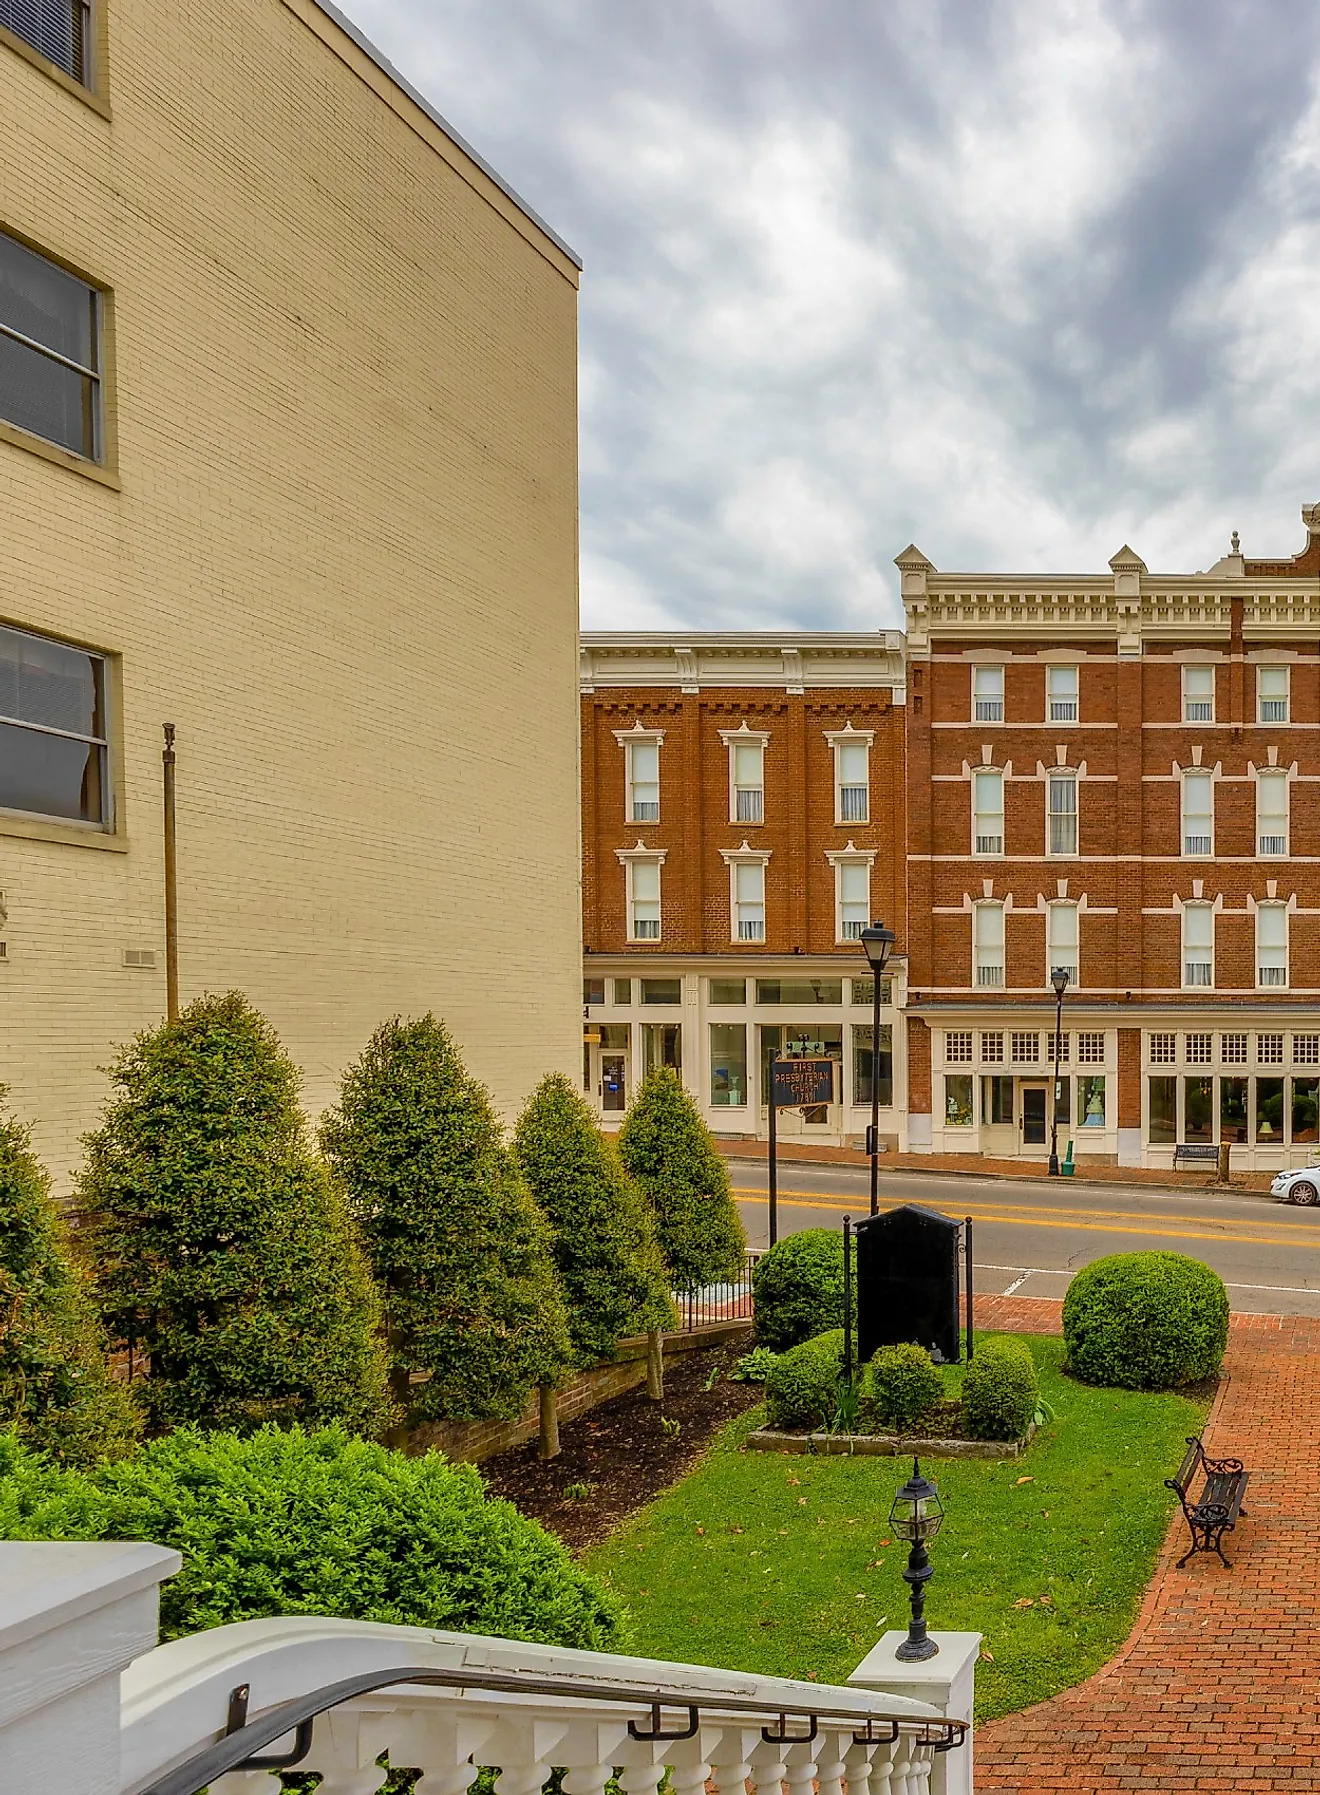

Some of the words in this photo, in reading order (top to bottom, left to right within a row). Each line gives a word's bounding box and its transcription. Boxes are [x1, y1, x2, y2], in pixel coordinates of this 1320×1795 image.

[793, 1062, 817, 1071] FIRST
[775, 1072, 828, 1083] PRESBYTERIAN
[790, 1082, 819, 1093] CHURCH
